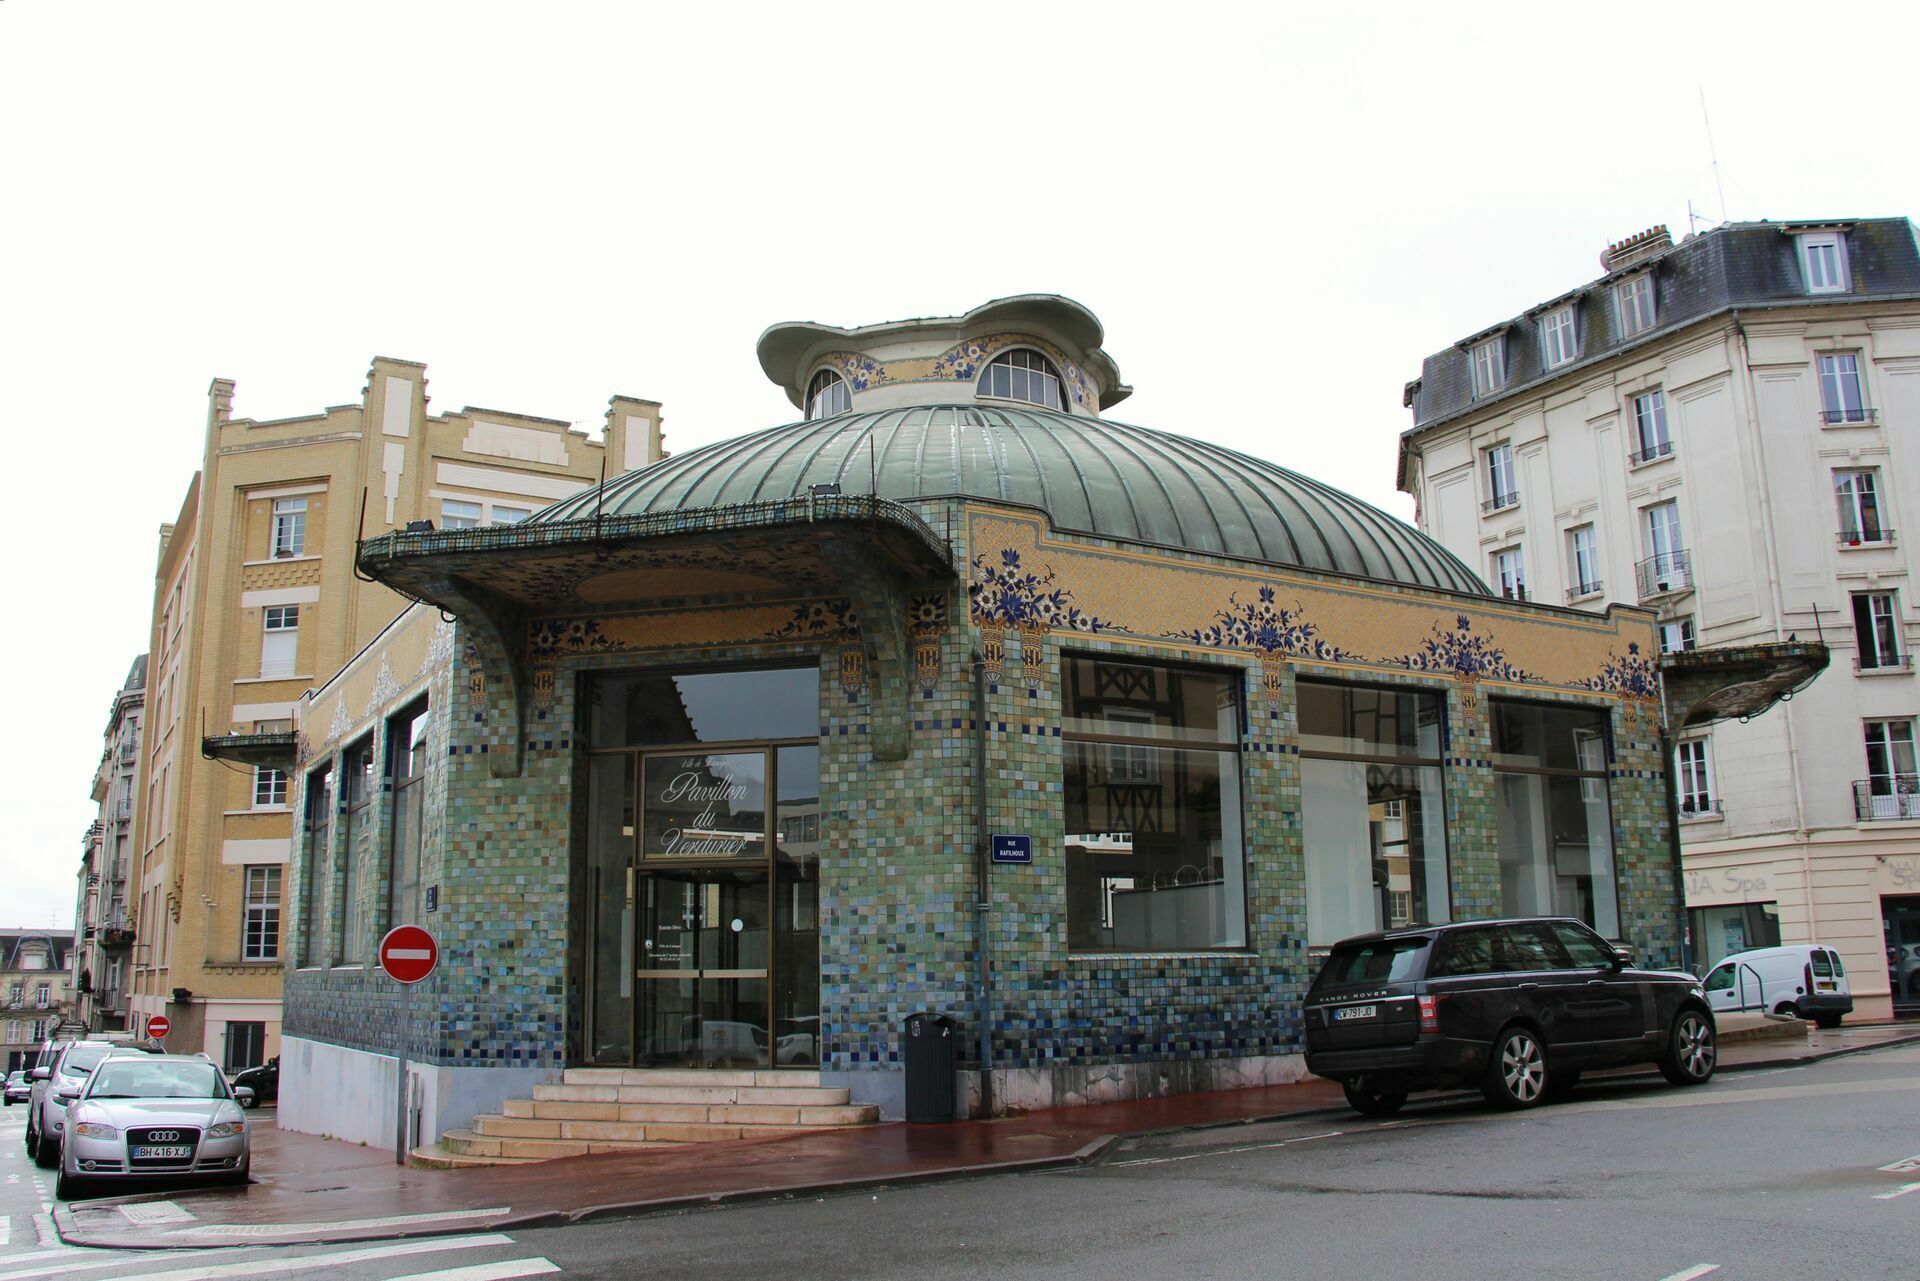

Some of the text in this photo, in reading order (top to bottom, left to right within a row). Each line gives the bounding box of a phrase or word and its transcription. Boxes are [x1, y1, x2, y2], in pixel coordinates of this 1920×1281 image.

[661, 772, 747, 803] Pavillon
[692, 801, 716, 828] du
[661, 828, 747, 857] Verdurier
[999, 849, 1025, 857] RAFILHOUX
[1722, 867, 1767, 901] Spa
[1353, 990, 1387, 999] ROVER
